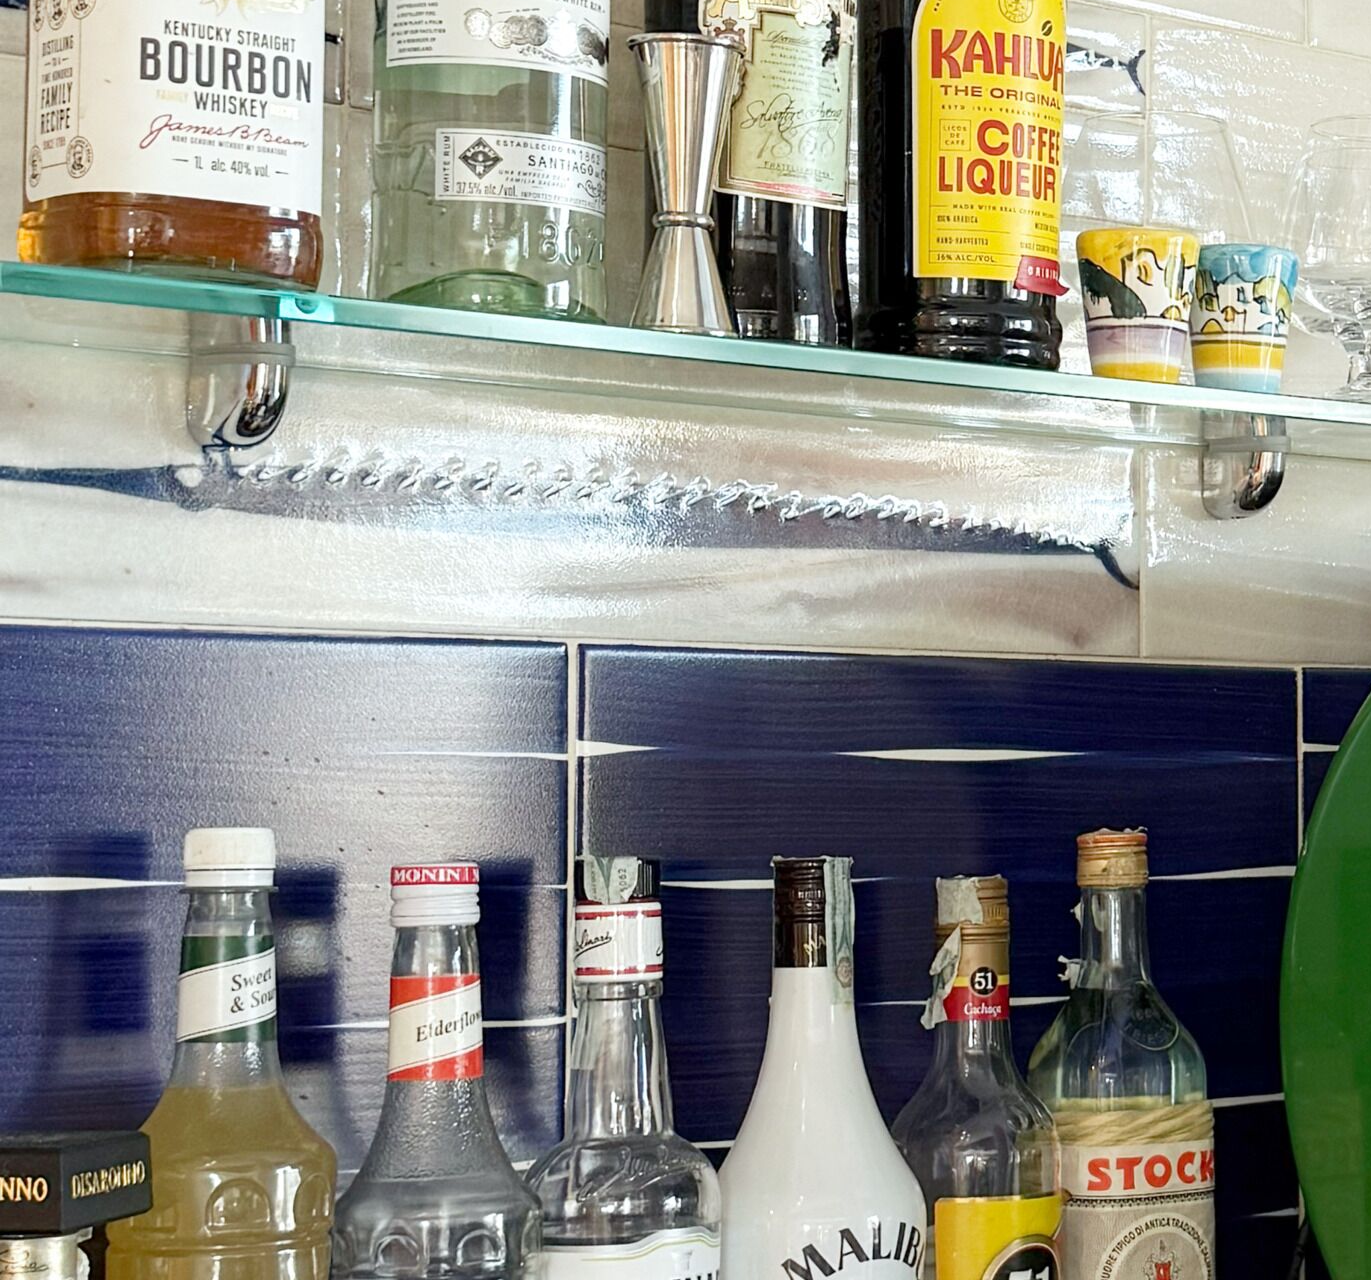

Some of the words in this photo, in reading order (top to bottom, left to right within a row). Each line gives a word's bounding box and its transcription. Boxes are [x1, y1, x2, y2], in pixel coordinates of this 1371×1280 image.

[42, 35, 74, 57] DISTILLING
[164, 19, 232, 43] KENTUCKY
[237, 30, 296, 53] STRAIGHT
[139, 36, 312, 103] BOURBON
[40, 82, 73, 109] FAMILY
[194, 91, 268, 119] WHISKEY
[940, 84, 983, 98] THE
[989, 87, 1061, 111] ORIGINAL
[40, 107, 71, 135] RECIPE
[442, 135, 451, 157] RUM
[496, 139, 563, 154] ESTABLECIDO
[977, 119, 1060, 167] COFFEE
[230, 160, 251, 176] 40%
[442, 160, 451, 193] WHITE
[528, 154, 594, 177] SANTIAGO
[456, 181, 483, 195] 37.5%
[938, 156, 1057, 204] LIQUEUR
[393, 867, 462, 884] MONIN
[231, 967, 273, 992] Sweet
[974, 972, 993, 990] 51
[230, 995, 245, 1014] &
[964, 1002, 1002, 1017] Cachaça
[416, 1010, 482, 1043] Elderflo
[72, 1160, 146, 1199] DISARONNO
[1087, 1150, 1215, 1191] STOCK
[1112, 1231, 1137, 1257] TIPICO
[1135, 1225, 1145, 1236] DI
[1144, 1217, 1171, 1232] ANTICA
